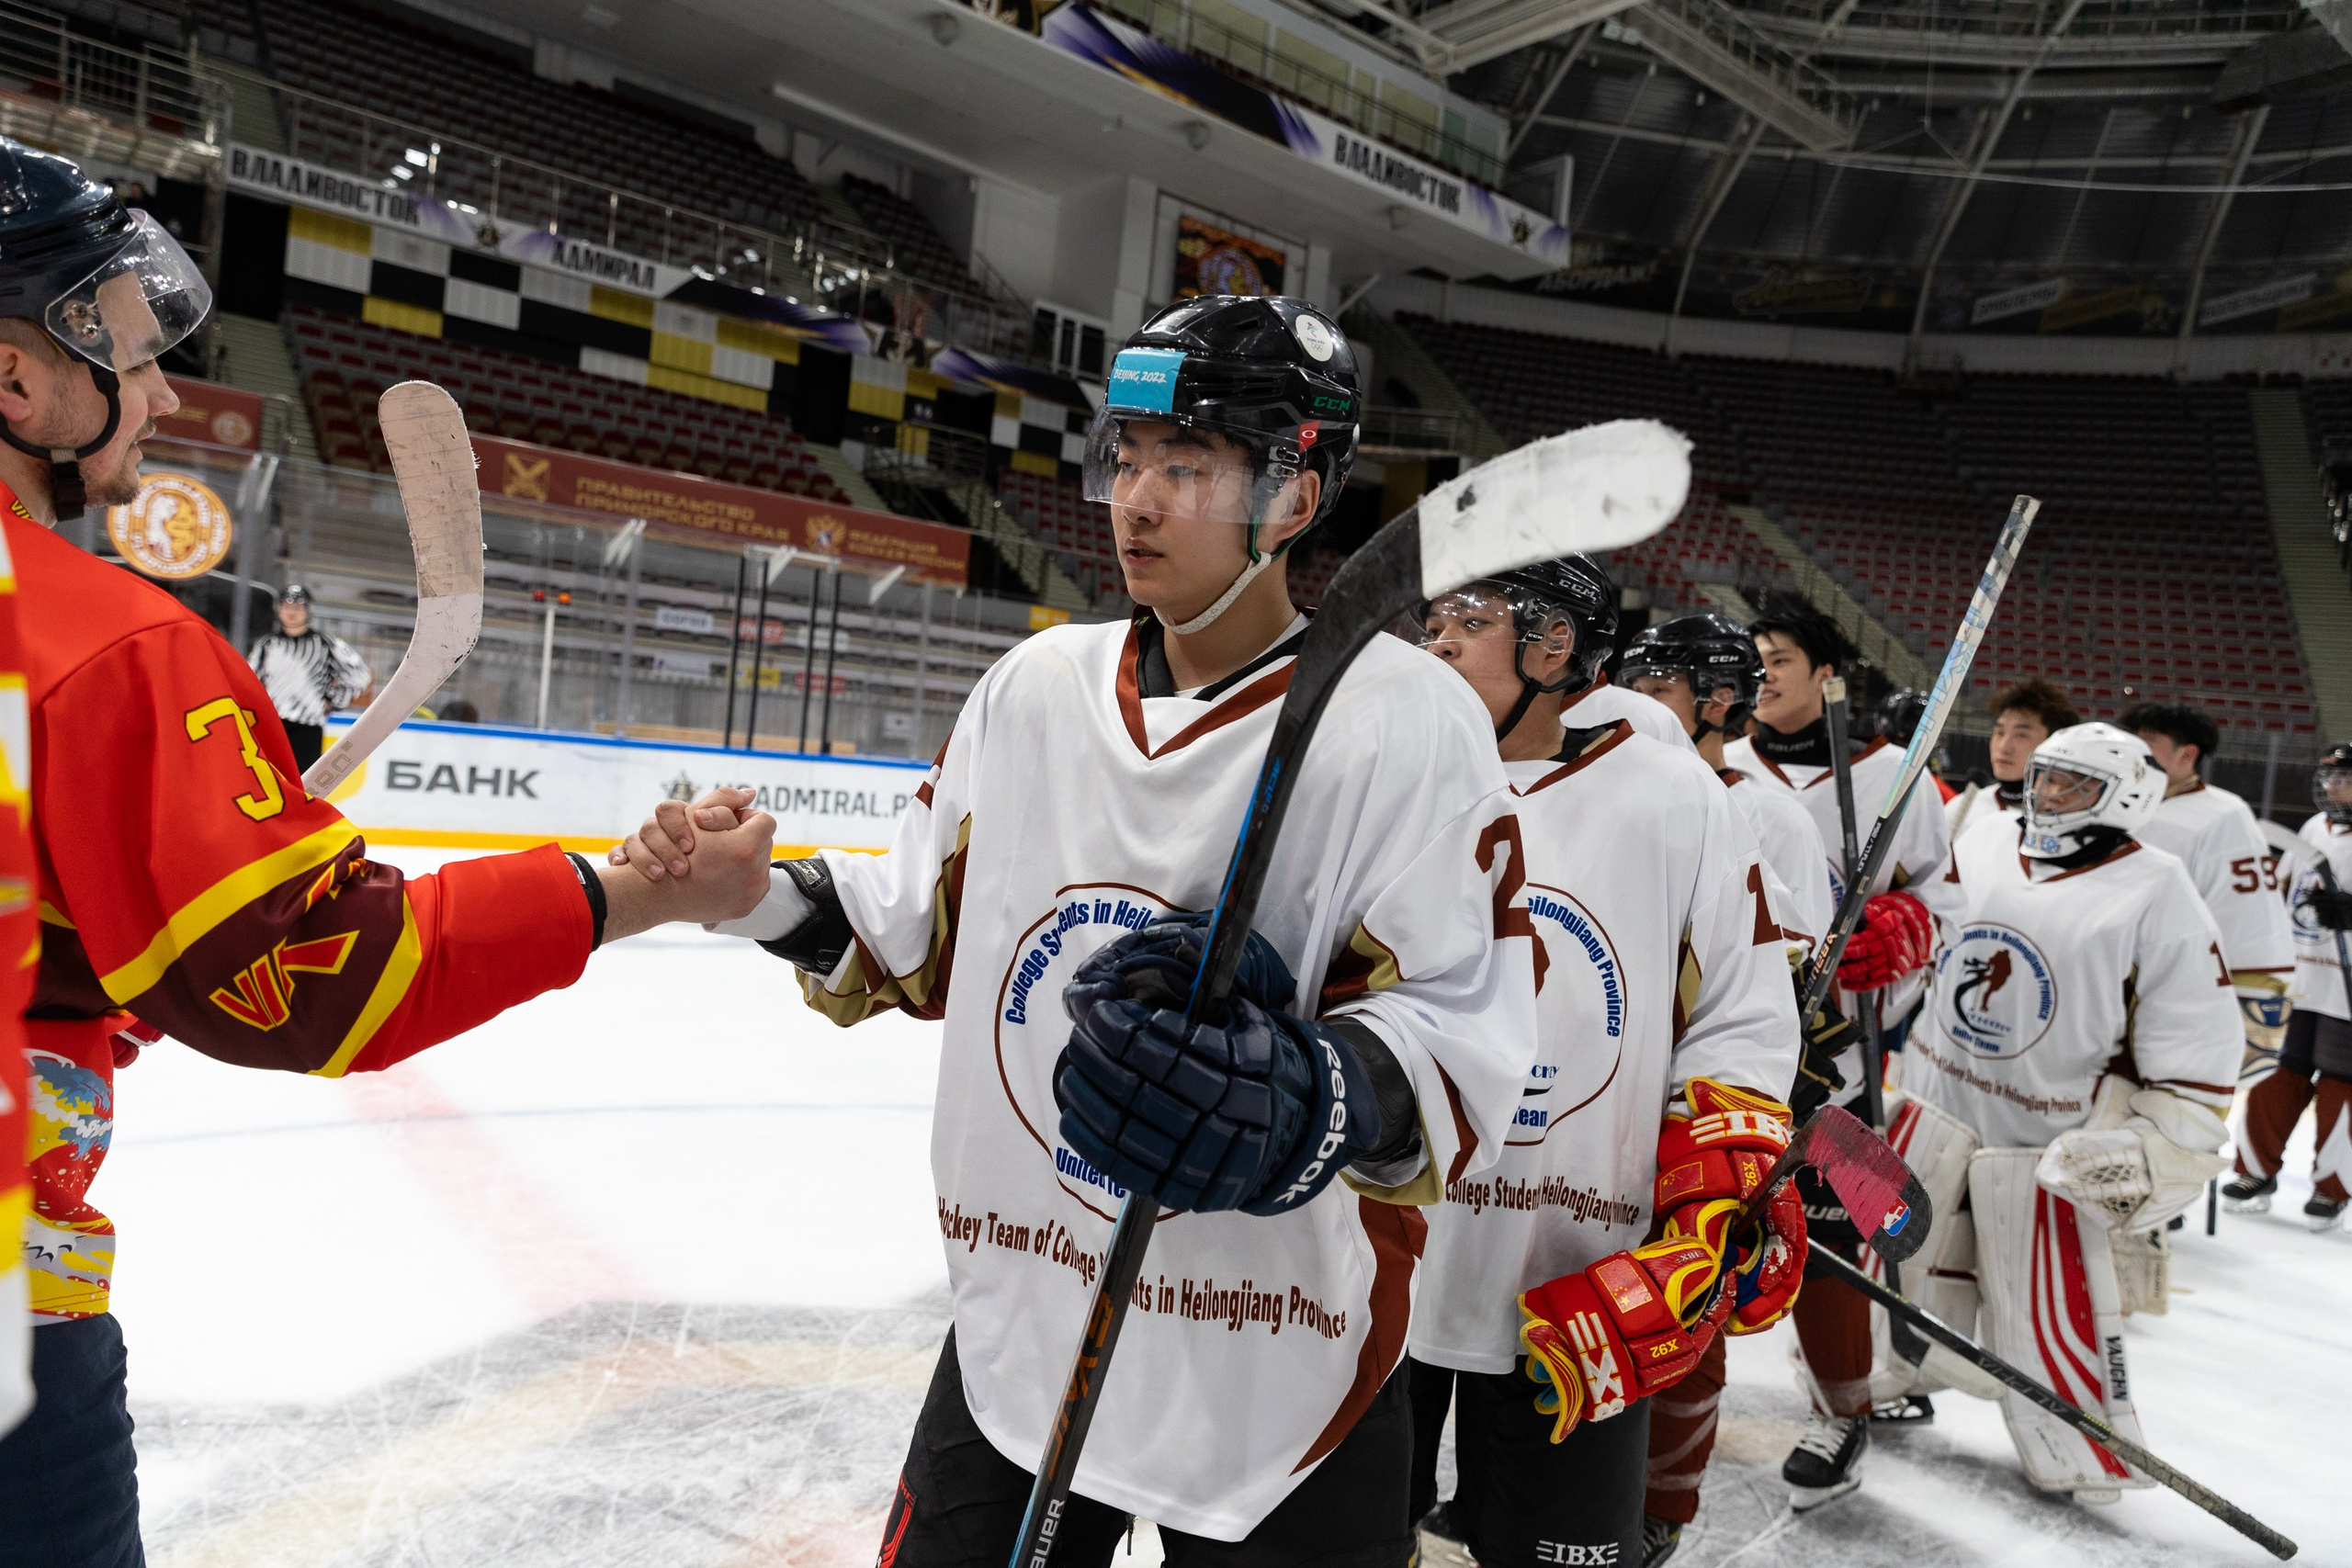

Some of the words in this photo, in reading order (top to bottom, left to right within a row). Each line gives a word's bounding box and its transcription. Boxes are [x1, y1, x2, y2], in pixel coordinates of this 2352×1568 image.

[232, 149, 419, 225] ВЛАДИВОСТОК
[1335, 134, 1460, 215] ВЛАДИВОСТОК
[1141, 371, 1167, 384] 2022
[1314, 395, 1351, 412] CCM
[576, 477, 755, 522] ПРАВИТЕЛЬСТВО
[1559, 579, 1596, 598] CCM
[1528, 632, 1544, 640] CCM
[1623, 647, 1646, 660] CCM
[1709, 655, 1740, 663] CCM
[386, 760, 541, 800] БАНК
[1005, 948, 1049, 1025] College
[1040, 901, 1090, 956] Stents
[1093, 898, 1112, 924] in
[1527, 895, 1606, 964] eilongjiang
[1598, 959, 1623, 1038] Province
[1274, 1037, 1351, 1203] Reebok
[1742, 1160, 1758, 1187] X92
[938, 1195, 982, 1253] Hockey
[987, 1212, 1030, 1252] Team
[1034, 1219, 1055, 1257] of
[1541, 1175, 1613, 1232] Heilongjiang
[1157, 1274, 1175, 1314] in
[1180, 1278, 1283, 1335] Heilongjiang
[1288, 1285, 1346, 1339] Province
[1650, 1338, 1680, 1359] X92
[2106, 1336, 2129, 1402] VAUGHN
[1029, 1498, 1066, 1568] AUER
[1546, 1541, 1614, 1568] IBX
